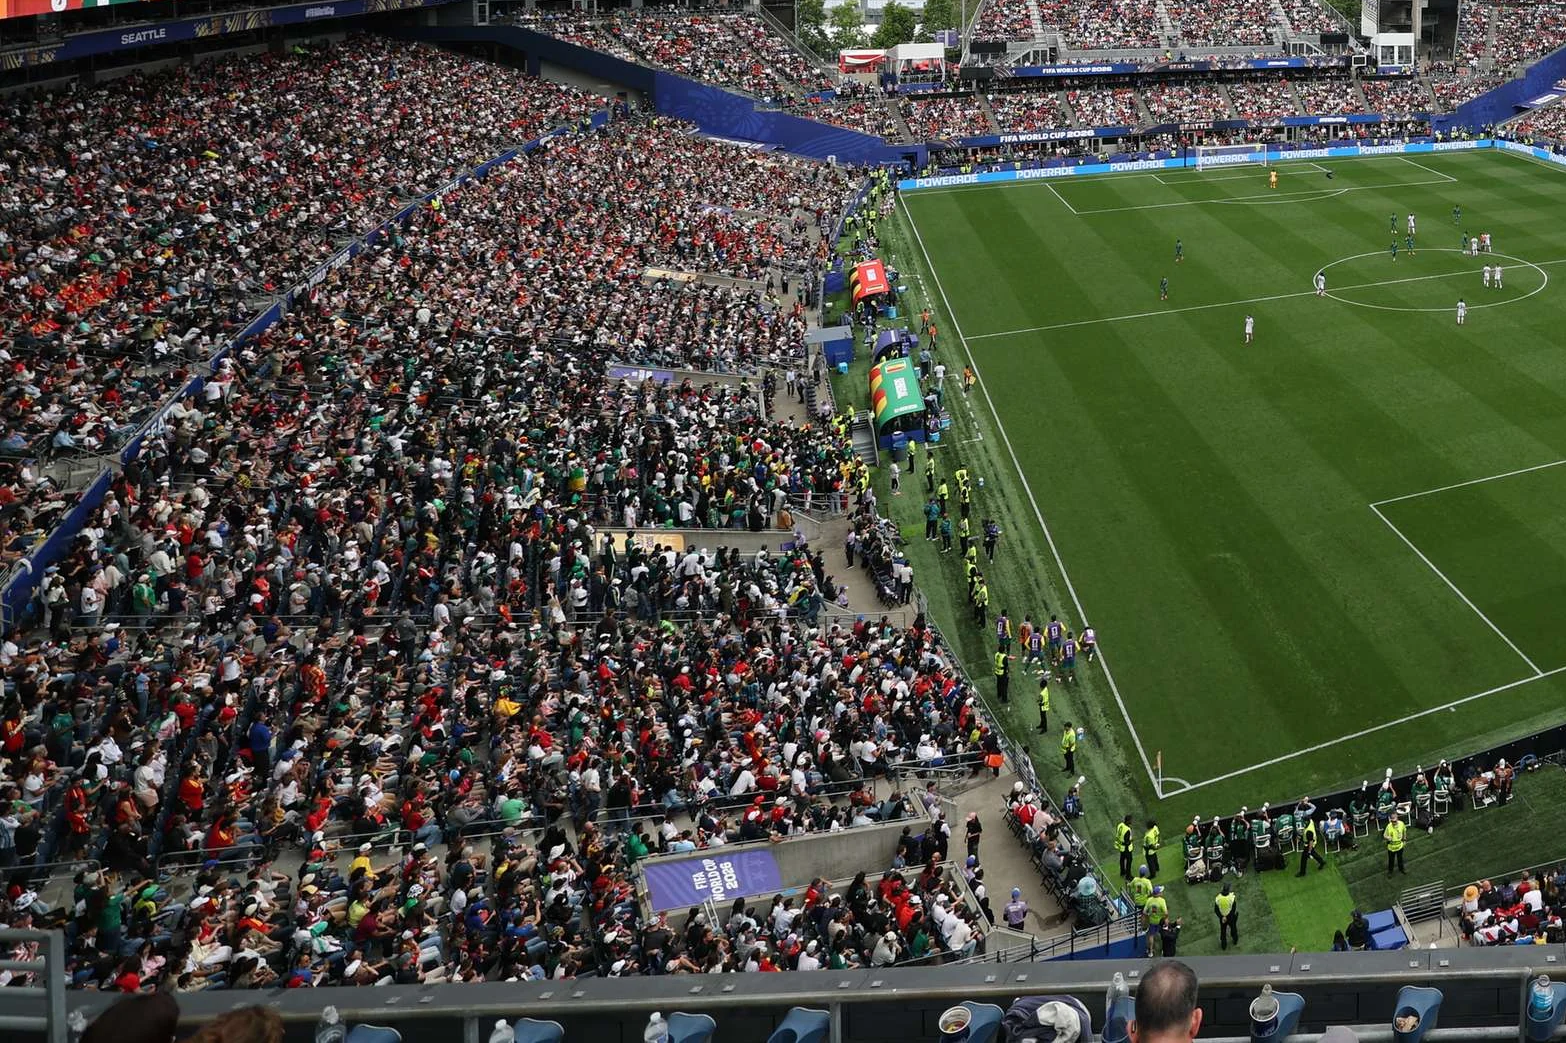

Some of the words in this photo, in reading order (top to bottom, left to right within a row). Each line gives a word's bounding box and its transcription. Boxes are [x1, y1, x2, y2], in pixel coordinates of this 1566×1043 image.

[120, 28, 166, 45] SEATTLE
[1018, 133, 1048, 141] WORLD
[1066, 130, 1095, 138] 2026
[1359, 145, 1405, 155] POWERADE
[1433, 141, 1477, 150] POWERADE
[1280, 148, 1329, 159] POWERADE
[1110, 160, 1165, 172] POWERADE
[1016, 166, 1075, 179] POWERADE
[916, 173, 979, 188] POWERADE
[702, 859, 717, 871] CUP
[692, 871, 708, 890] FIFA
[719, 862, 739, 890] 2026
[708, 870, 726, 902] WORLD
